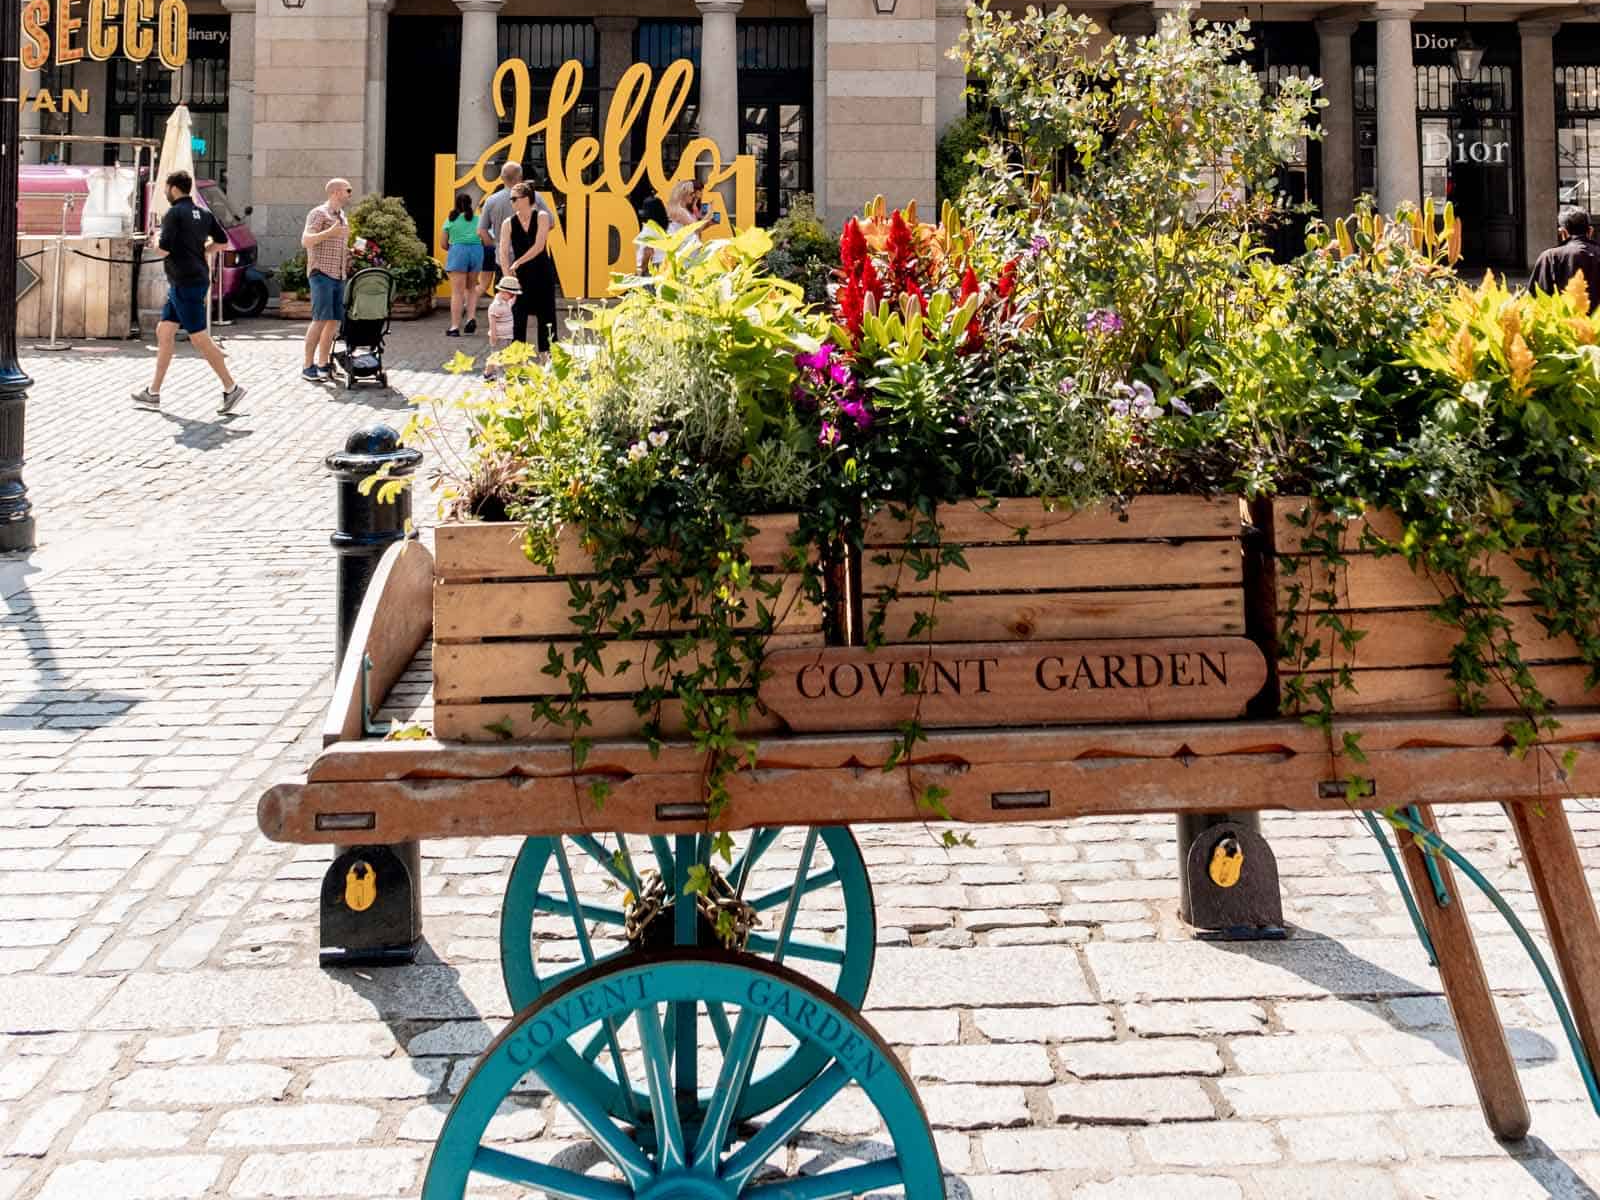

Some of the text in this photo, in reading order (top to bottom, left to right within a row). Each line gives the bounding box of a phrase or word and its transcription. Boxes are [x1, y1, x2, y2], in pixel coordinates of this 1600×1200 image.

[1414, 33, 1457, 49] Dior
[454, 58, 737, 200] Hello
[1424, 132, 1509, 163] Dior
[796, 651, 1230, 699] COVENT GARDEN
[506, 971, 886, 1080] COVENT GARDEN
